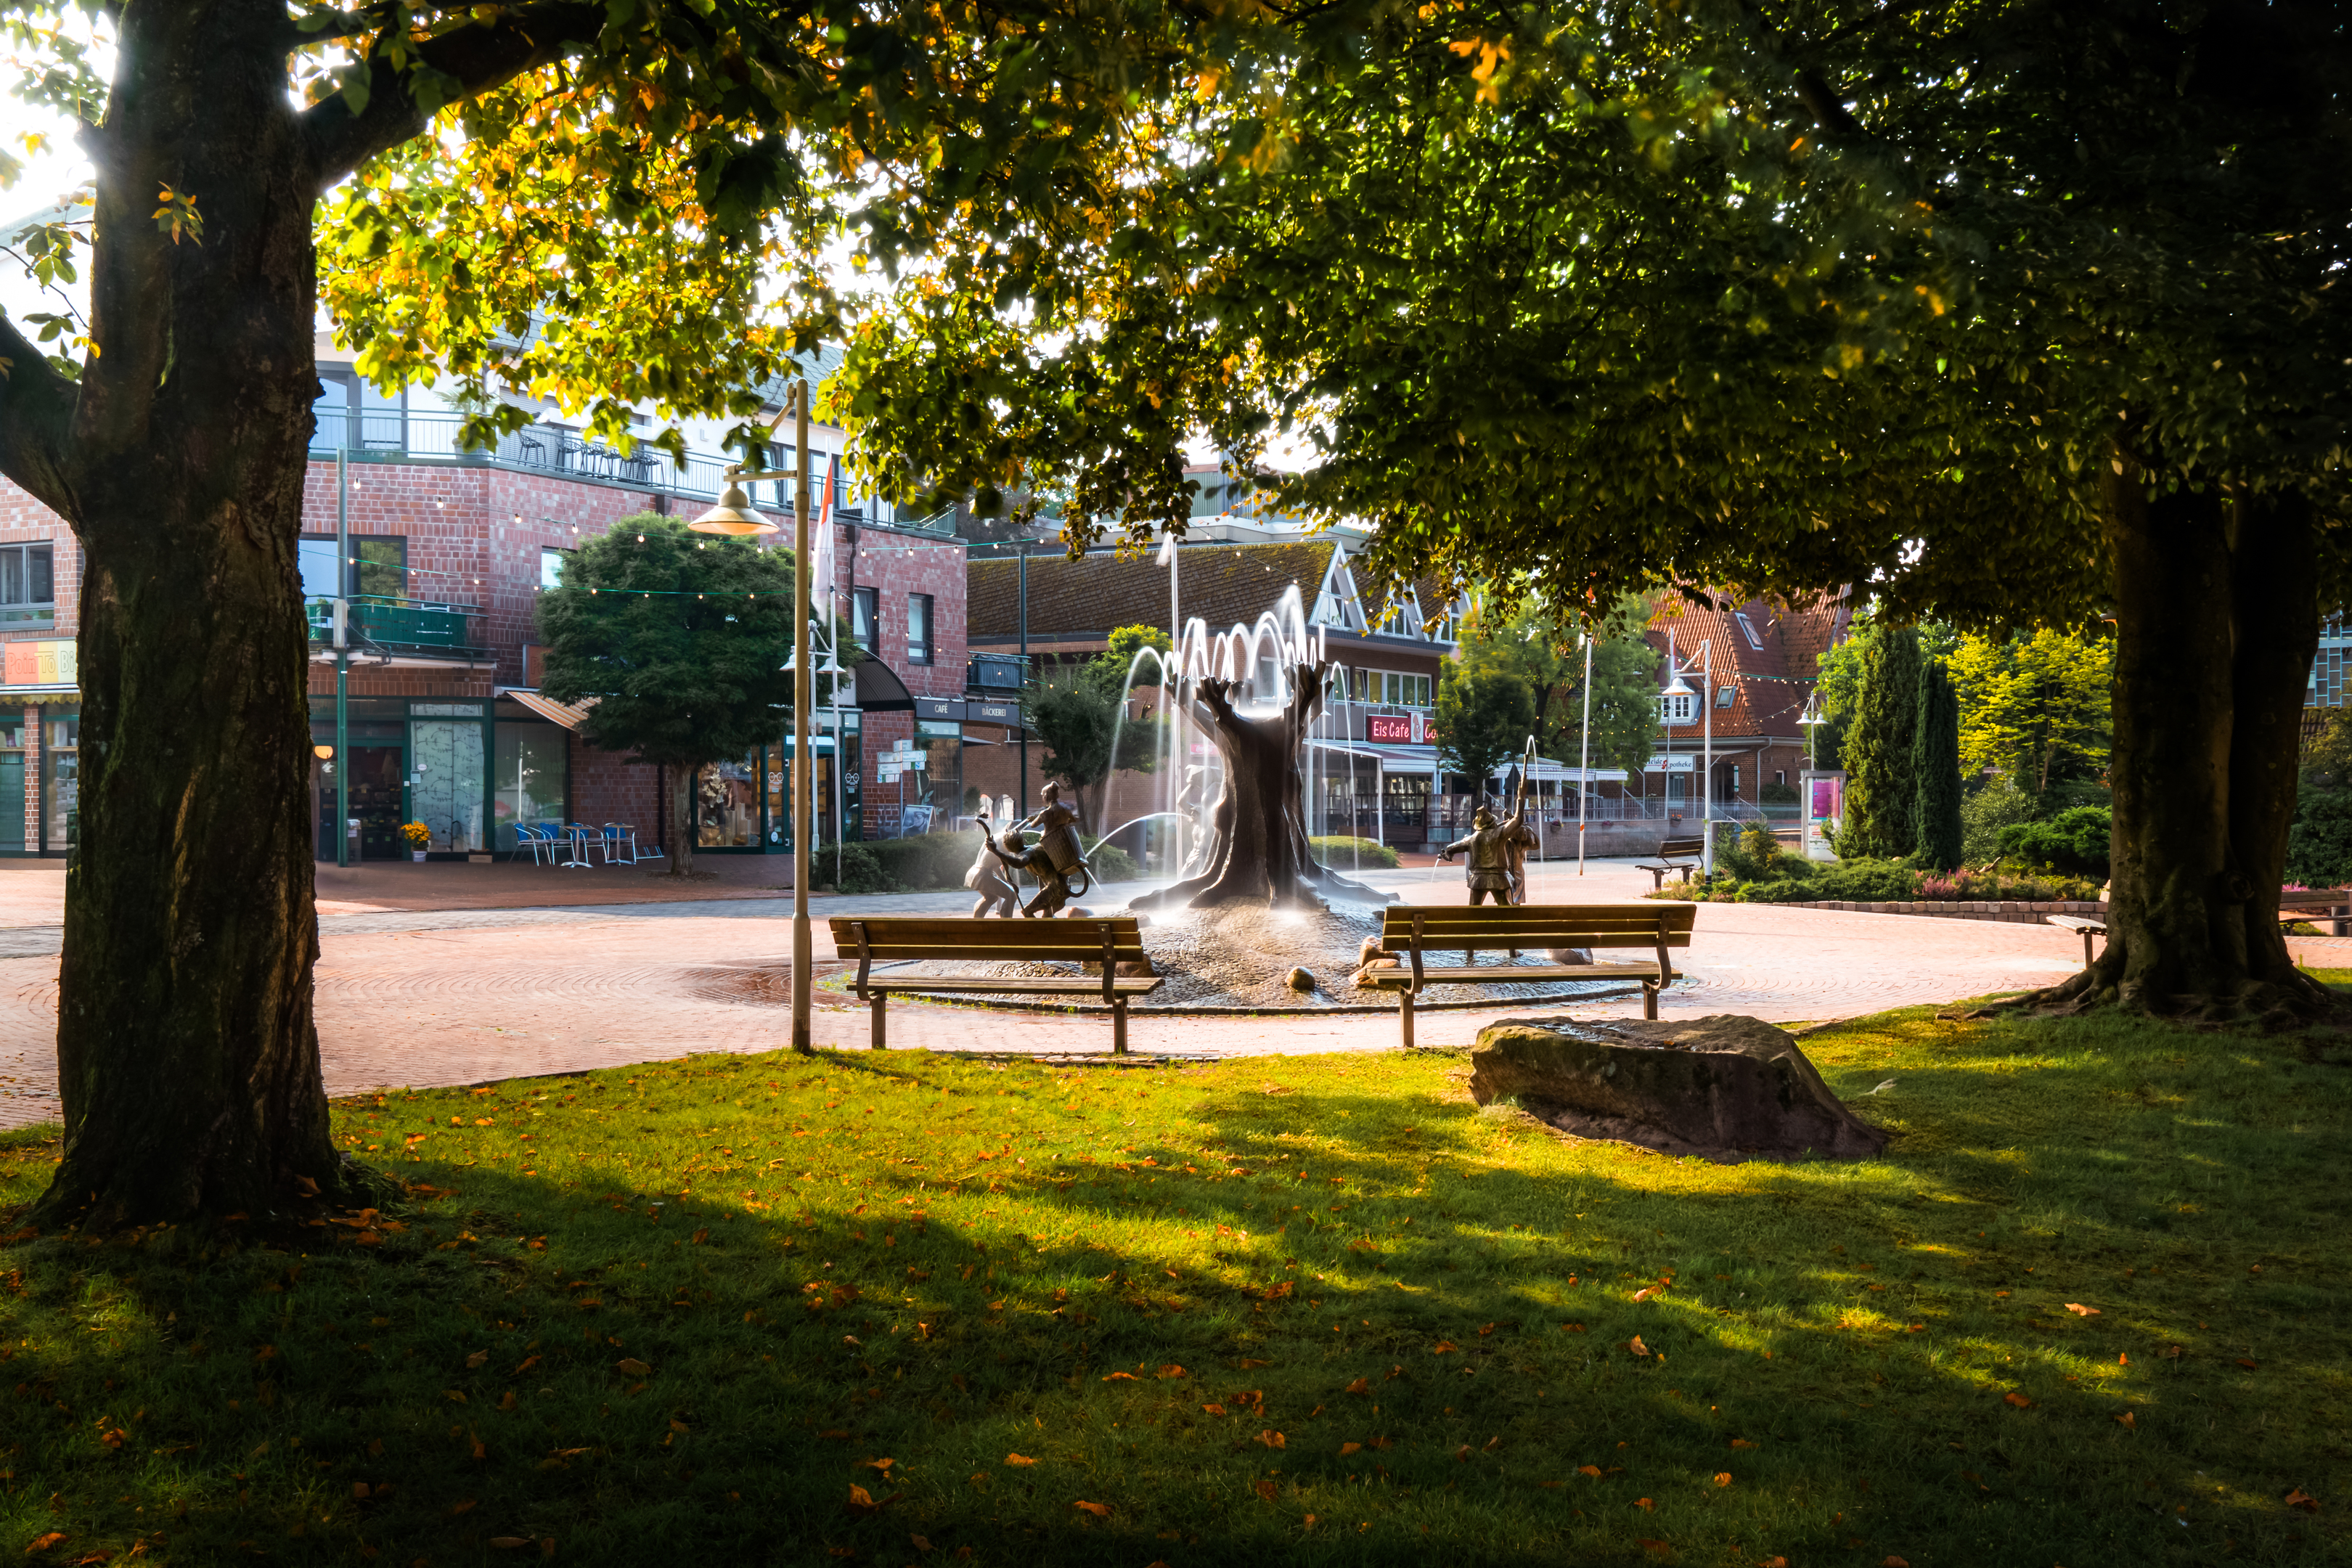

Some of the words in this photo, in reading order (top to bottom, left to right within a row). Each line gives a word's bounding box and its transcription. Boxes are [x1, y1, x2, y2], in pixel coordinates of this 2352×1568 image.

[60, 650, 77, 673] Bi
[934, 703, 947, 714] CAFÉ
[981, 706, 1006, 716] BÄCKEREI
[1373, 721, 1387, 738] Eis
[1389, 722, 1410, 738] Cafe
[1424, 724, 1438, 739] Co
